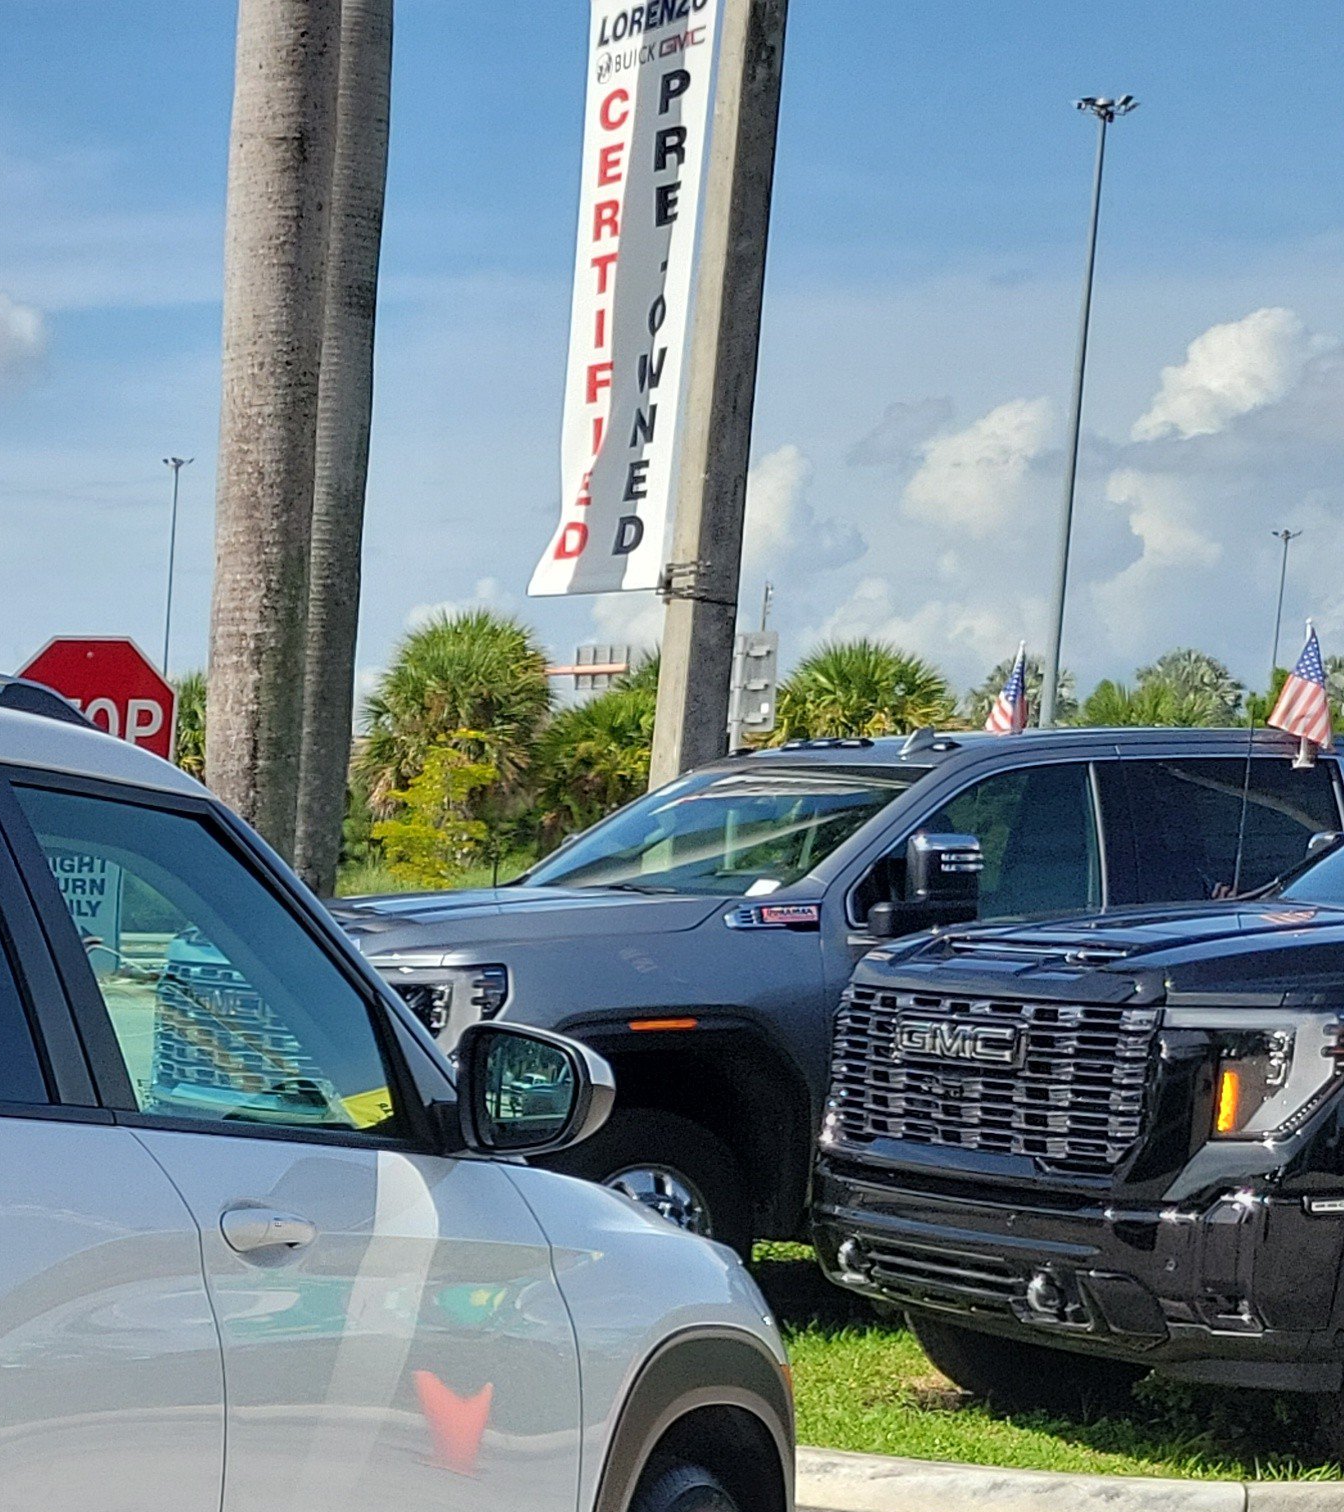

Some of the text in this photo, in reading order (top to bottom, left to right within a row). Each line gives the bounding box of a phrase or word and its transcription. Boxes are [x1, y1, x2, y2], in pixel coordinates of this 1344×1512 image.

[614, 26, 706, 73] BUICK GMC
[52, 856, 106, 873] IGHT
[57, 877, 106, 896] URN
[900, 1020, 1013, 1062] GMC
